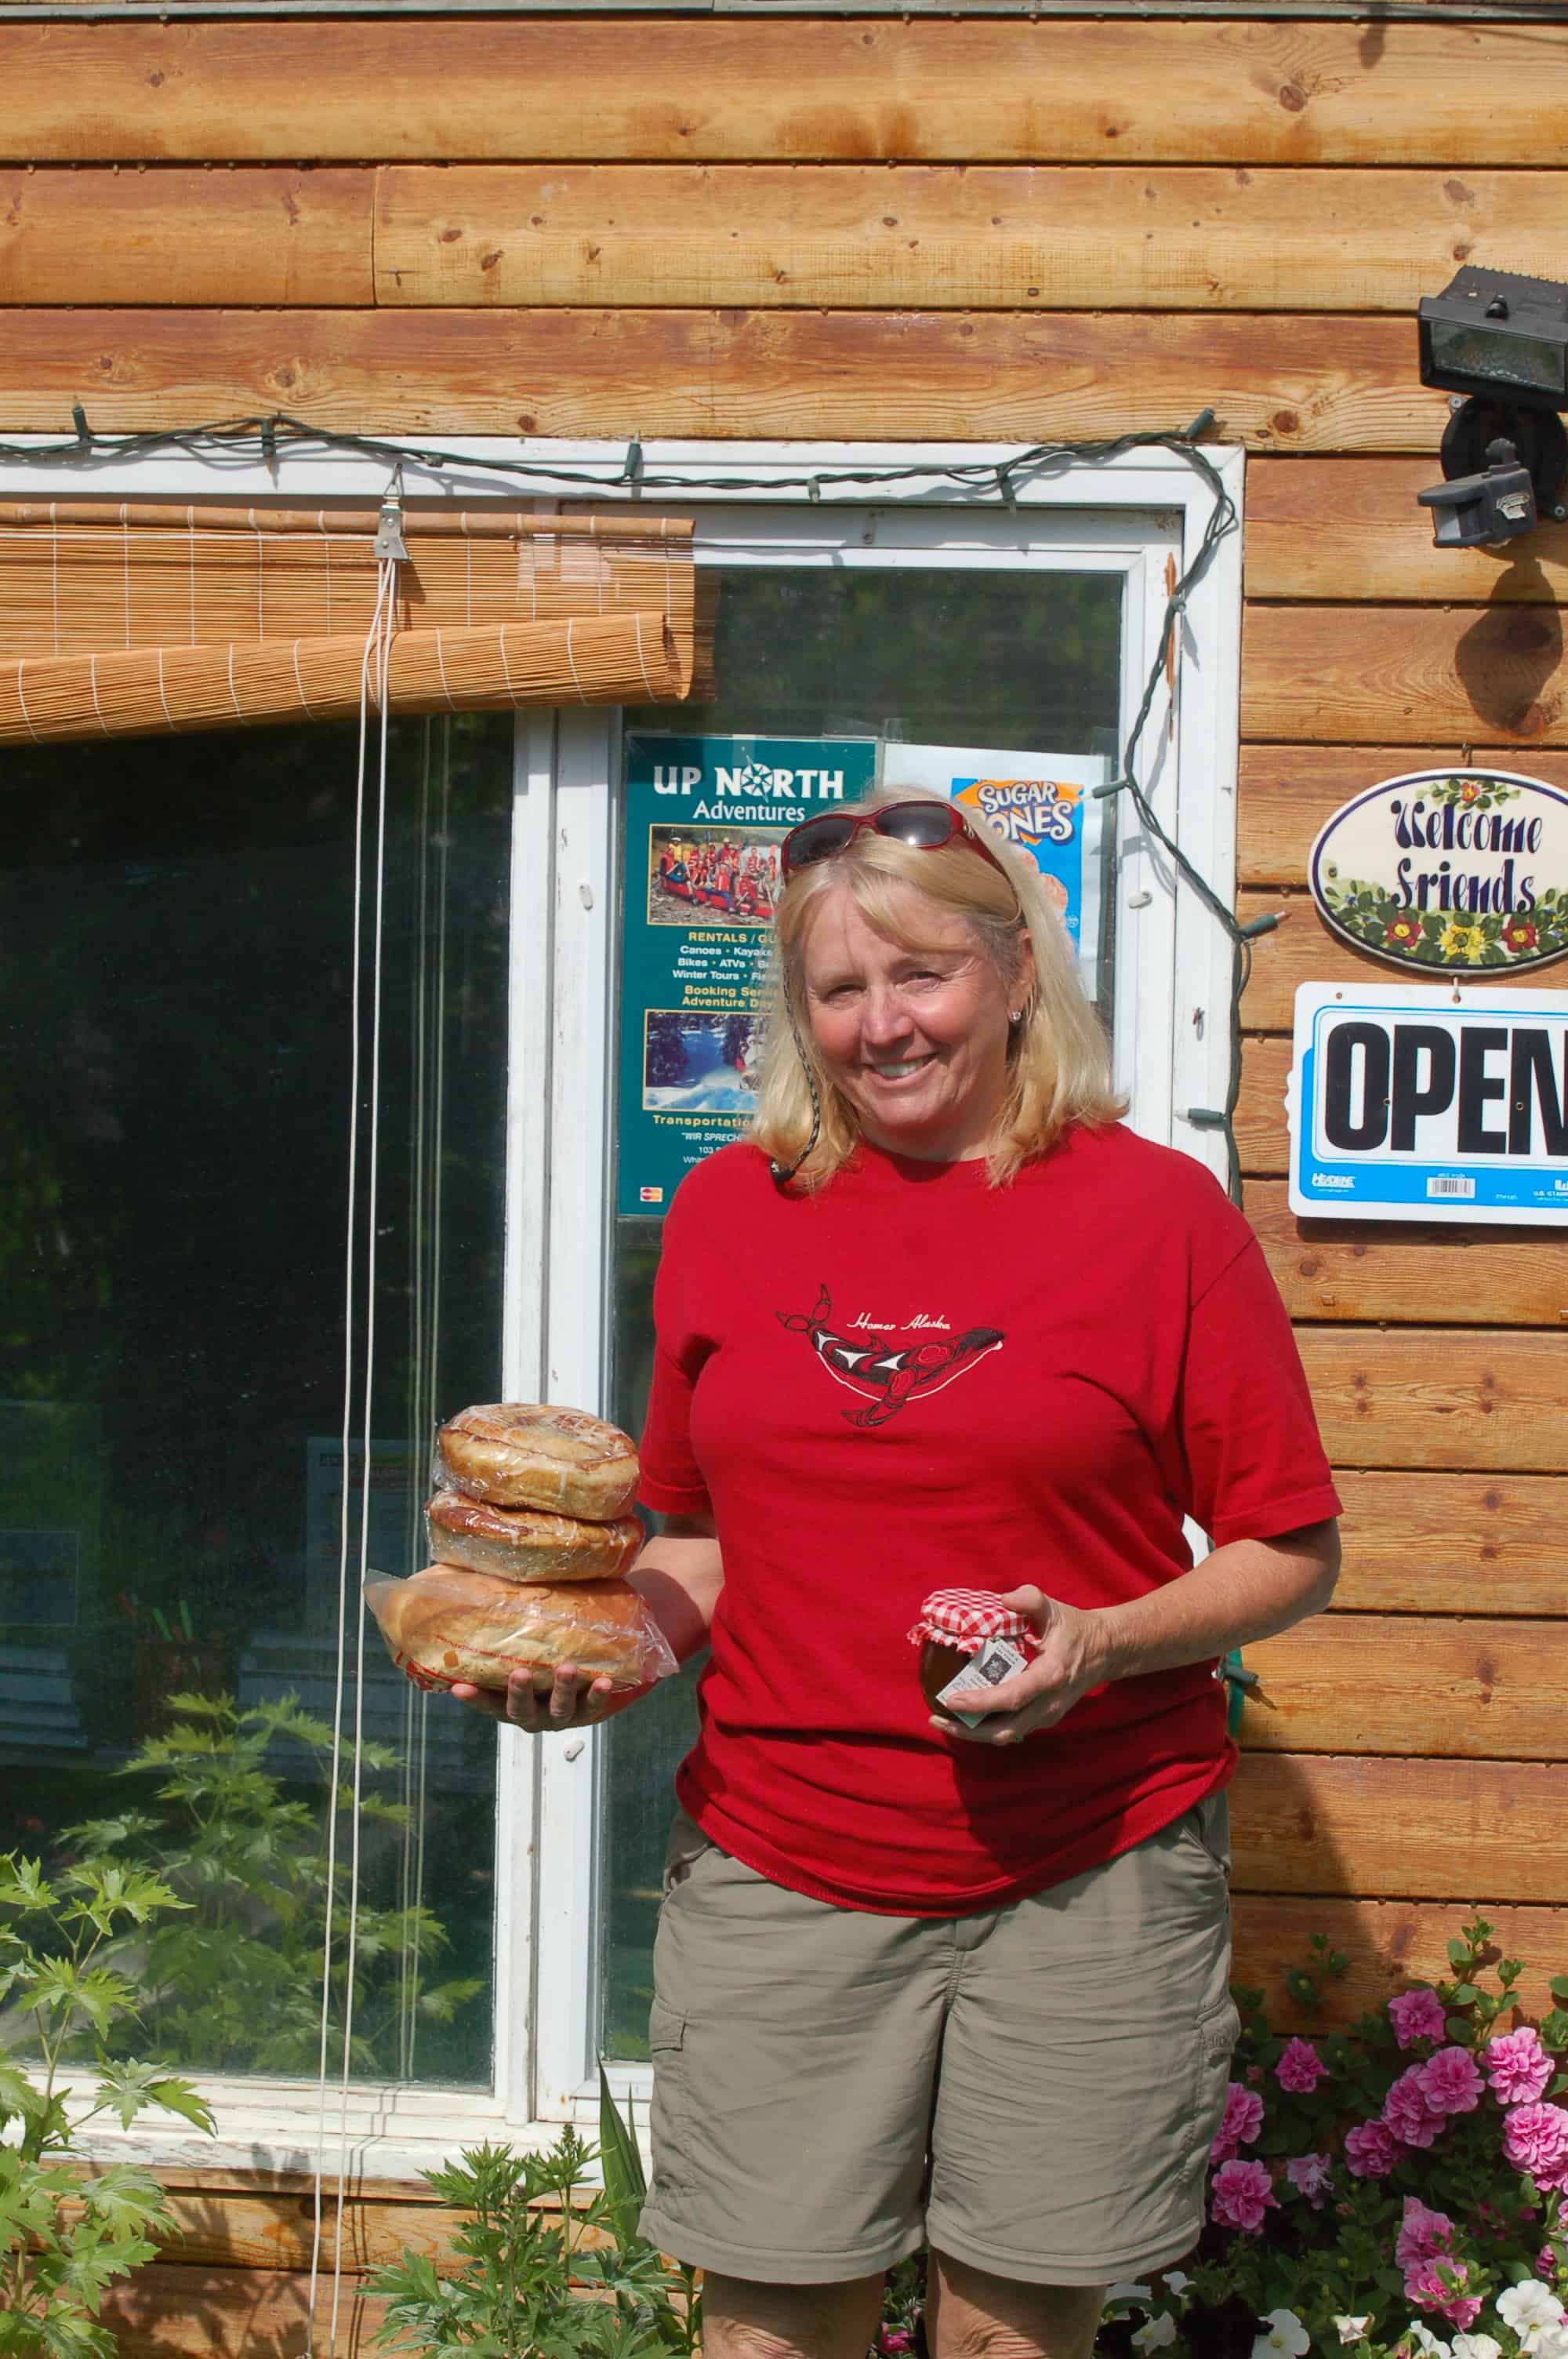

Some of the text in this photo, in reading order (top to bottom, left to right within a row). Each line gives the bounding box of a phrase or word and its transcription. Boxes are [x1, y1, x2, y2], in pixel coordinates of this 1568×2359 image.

[653, 762, 844, 799] UP NORTH
[979, 783, 1056, 812] SUGAR
[692, 800, 806, 822] Adventures
[969, 801, 1073, 841] ONES
[1391, 799, 1543, 854] Welcome
[688, 931, 747, 943] RENTALS
[680, 945, 722, 955] Canoes
[677, 958, 746, 968] Bikes ATVs
[672, 969, 739, 980] Winter Tours
[684, 985, 736, 998] Booking
[682, 996, 746, 1008] Adventure
[1324, 1021, 1568, 1156] OPEN
[703, 1132, 743, 1142] SPRECH
[847, 1312, 951, 1330] Homer Alaska
